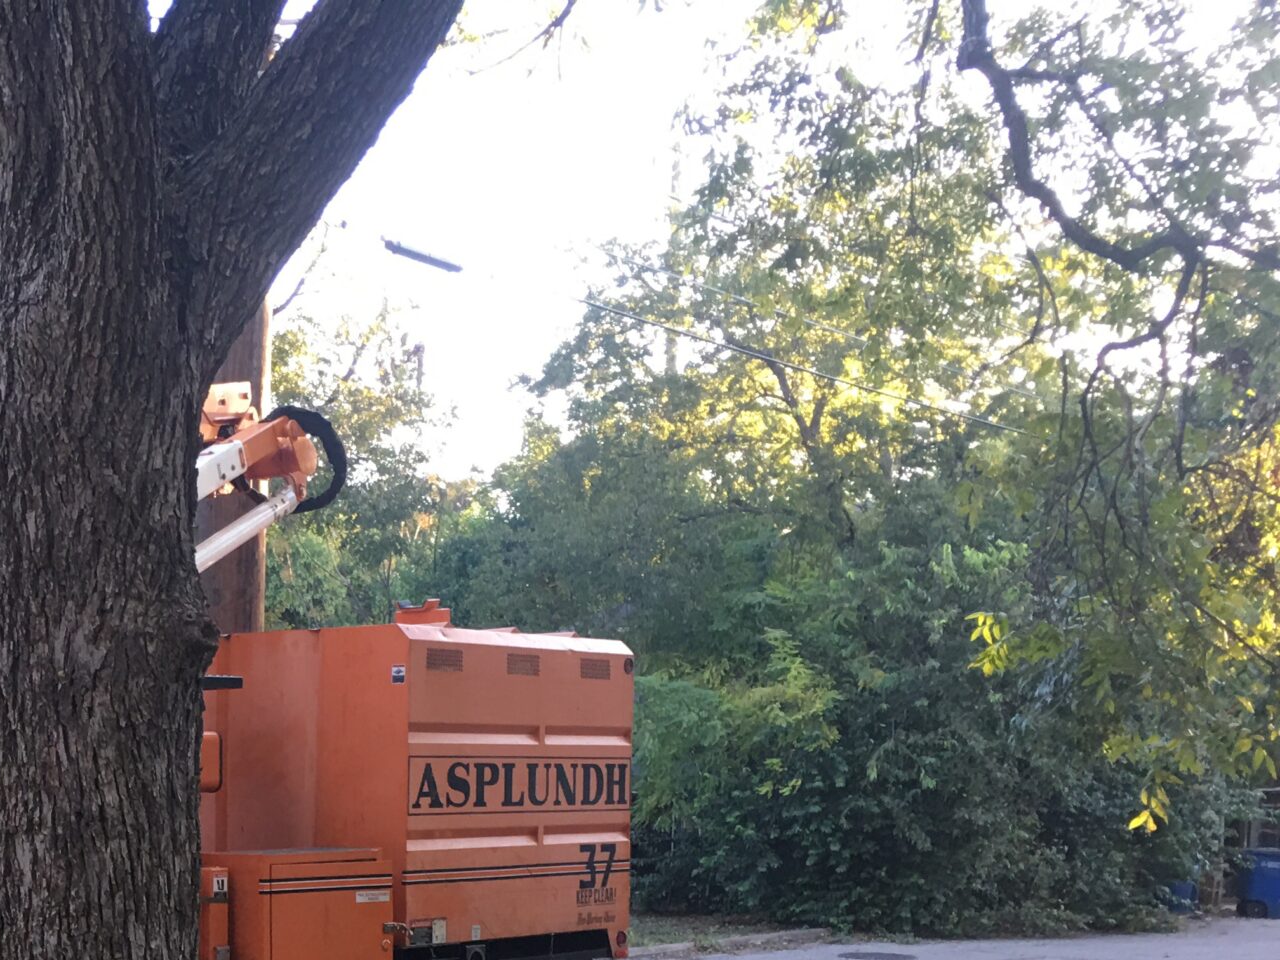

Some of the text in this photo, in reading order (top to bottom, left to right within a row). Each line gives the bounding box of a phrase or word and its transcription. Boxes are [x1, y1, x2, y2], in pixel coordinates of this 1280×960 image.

[411, 761, 628, 809] ASPLUNDH
[579, 843, 617, 889] 37
[576, 888, 593, 905] KEEP
